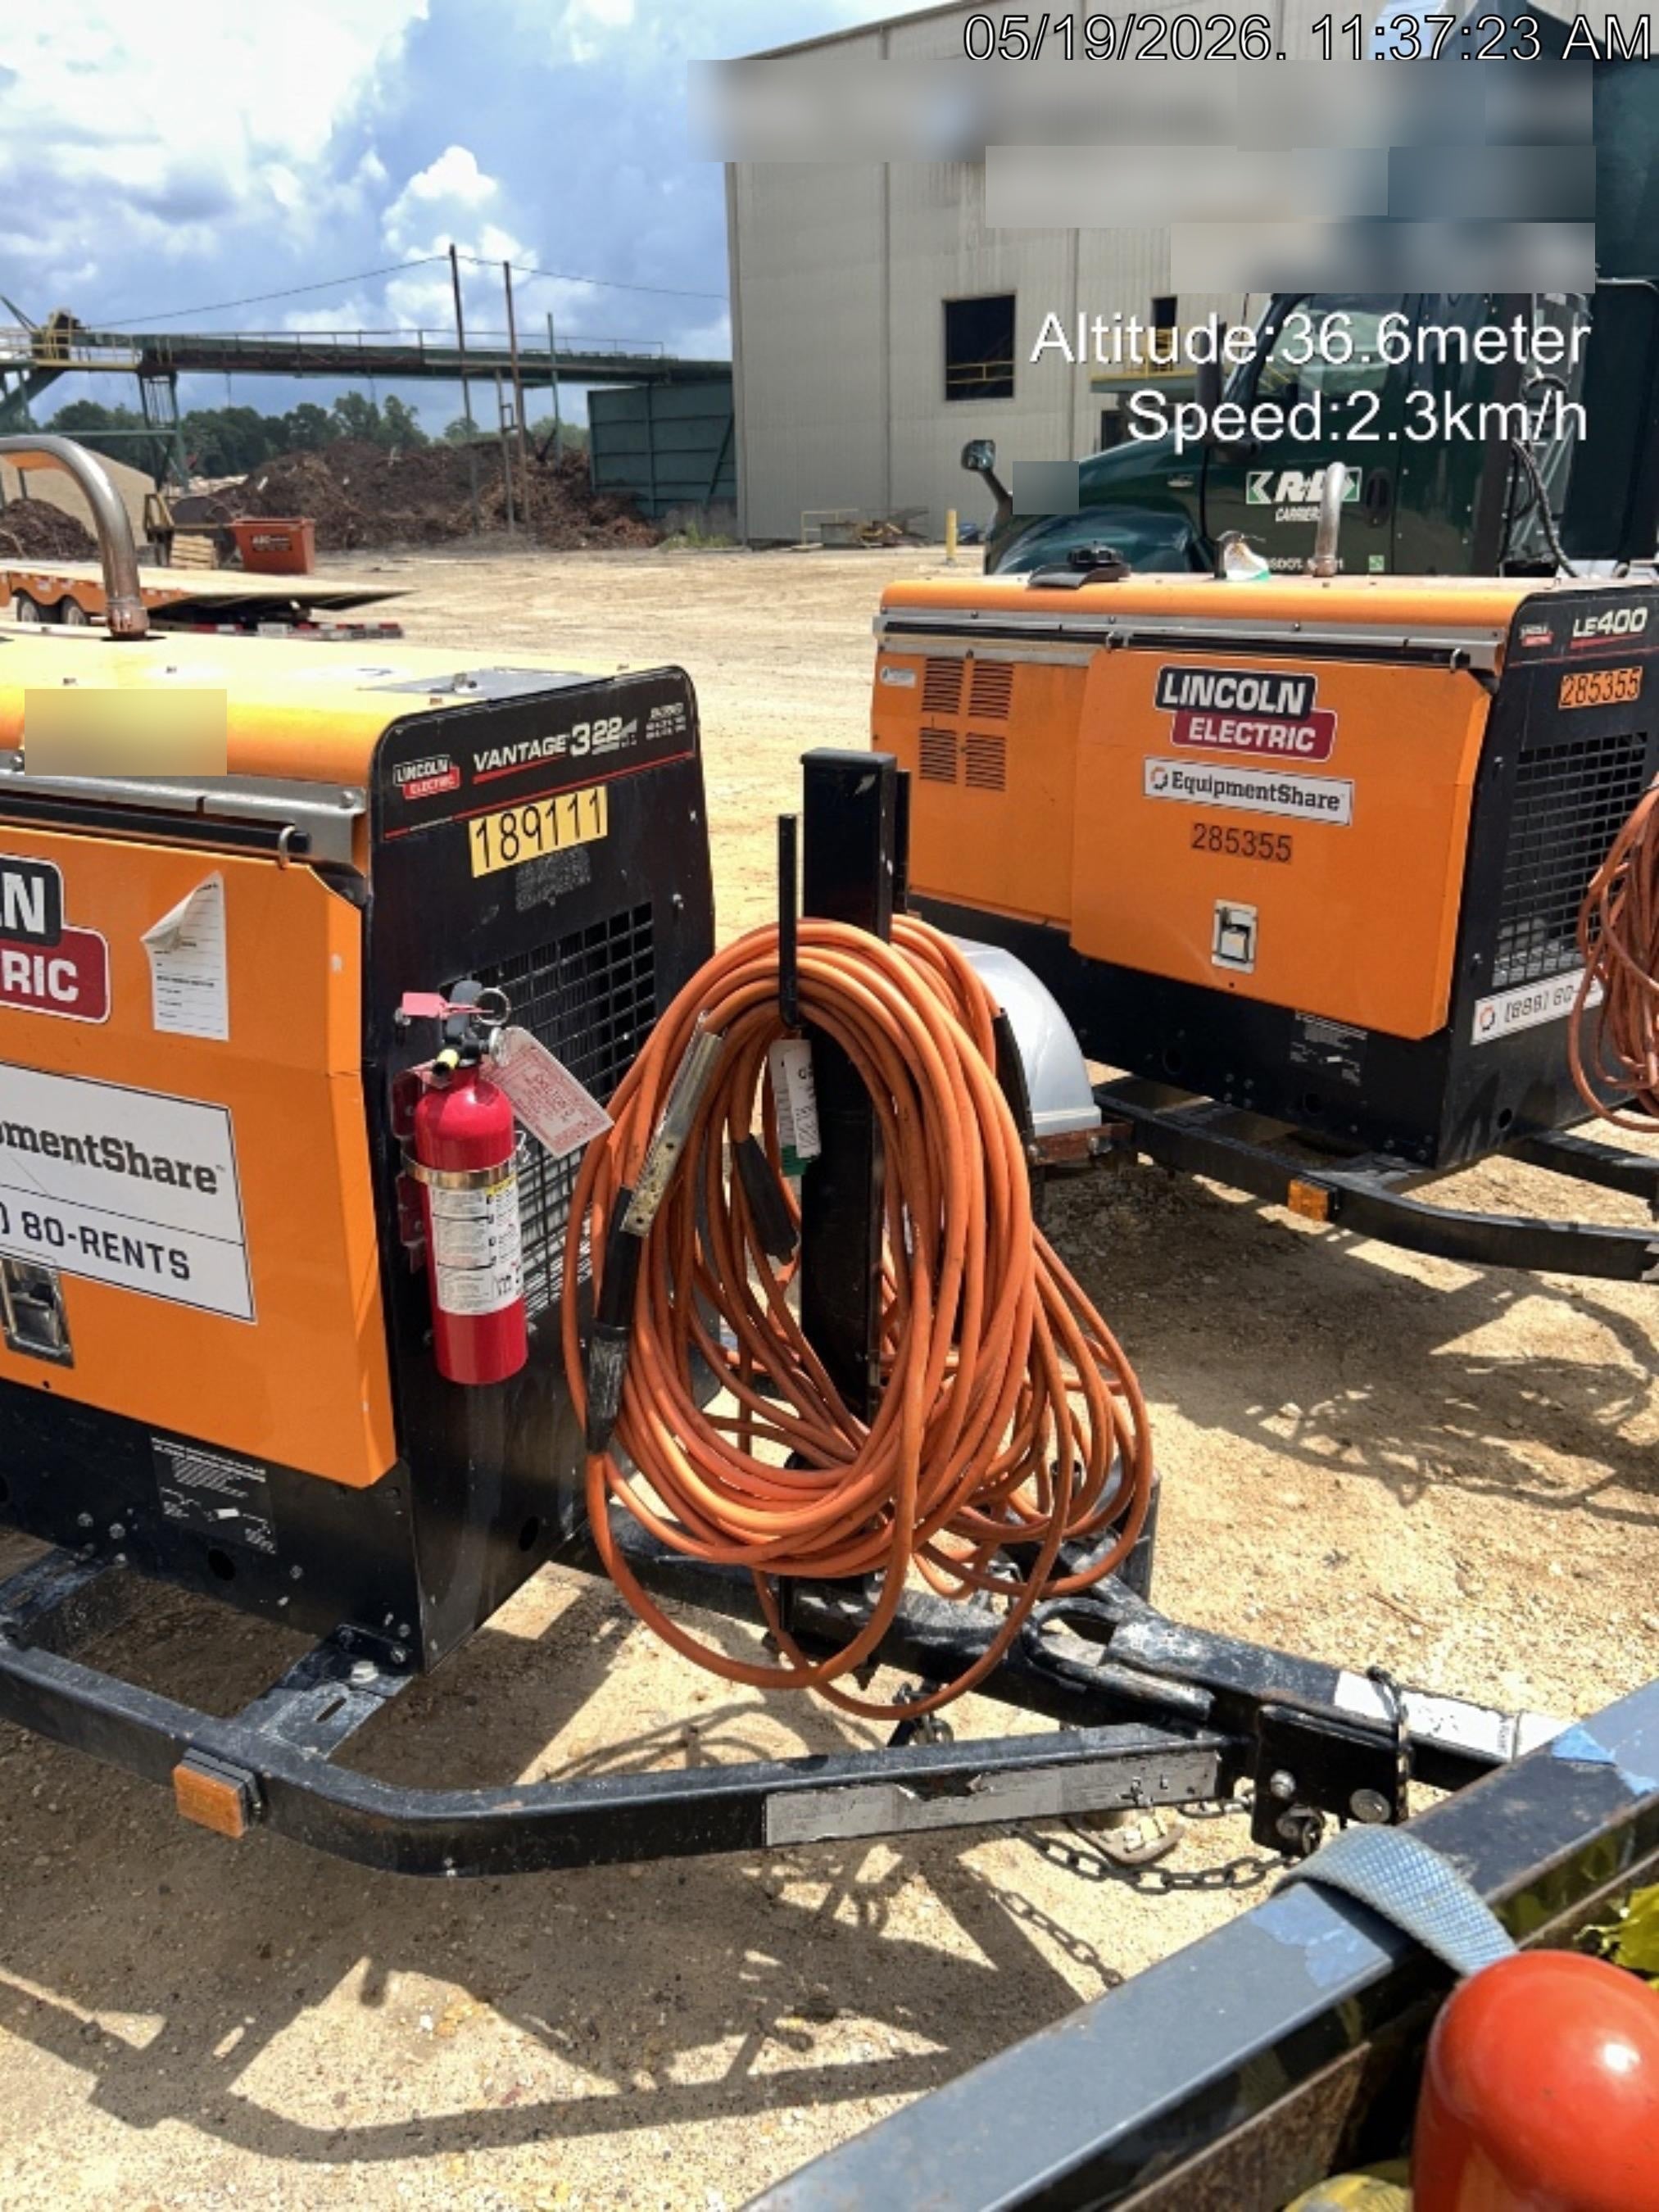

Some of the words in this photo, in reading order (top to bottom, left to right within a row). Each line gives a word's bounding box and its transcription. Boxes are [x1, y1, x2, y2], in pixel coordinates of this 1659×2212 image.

[1572, 606, 1648, 637] LE400
[1162, 673, 1307, 715] LINCOLN
[1560, 667, 1639, 705] 285355
[472, 734, 567, 773] VANTAGE
[1189, 717, 1316, 752] ELECTRIC
[1172, 771, 1340, 811] EquipmentShare
[475, 788, 601, 868] 189111
[1191, 823, 1292, 863] 285355
[0, 872, 46, 935] N
[0, 1120, 218, 1195] mentShare
[20, 1210, 191, 1281] 80-RENTS
